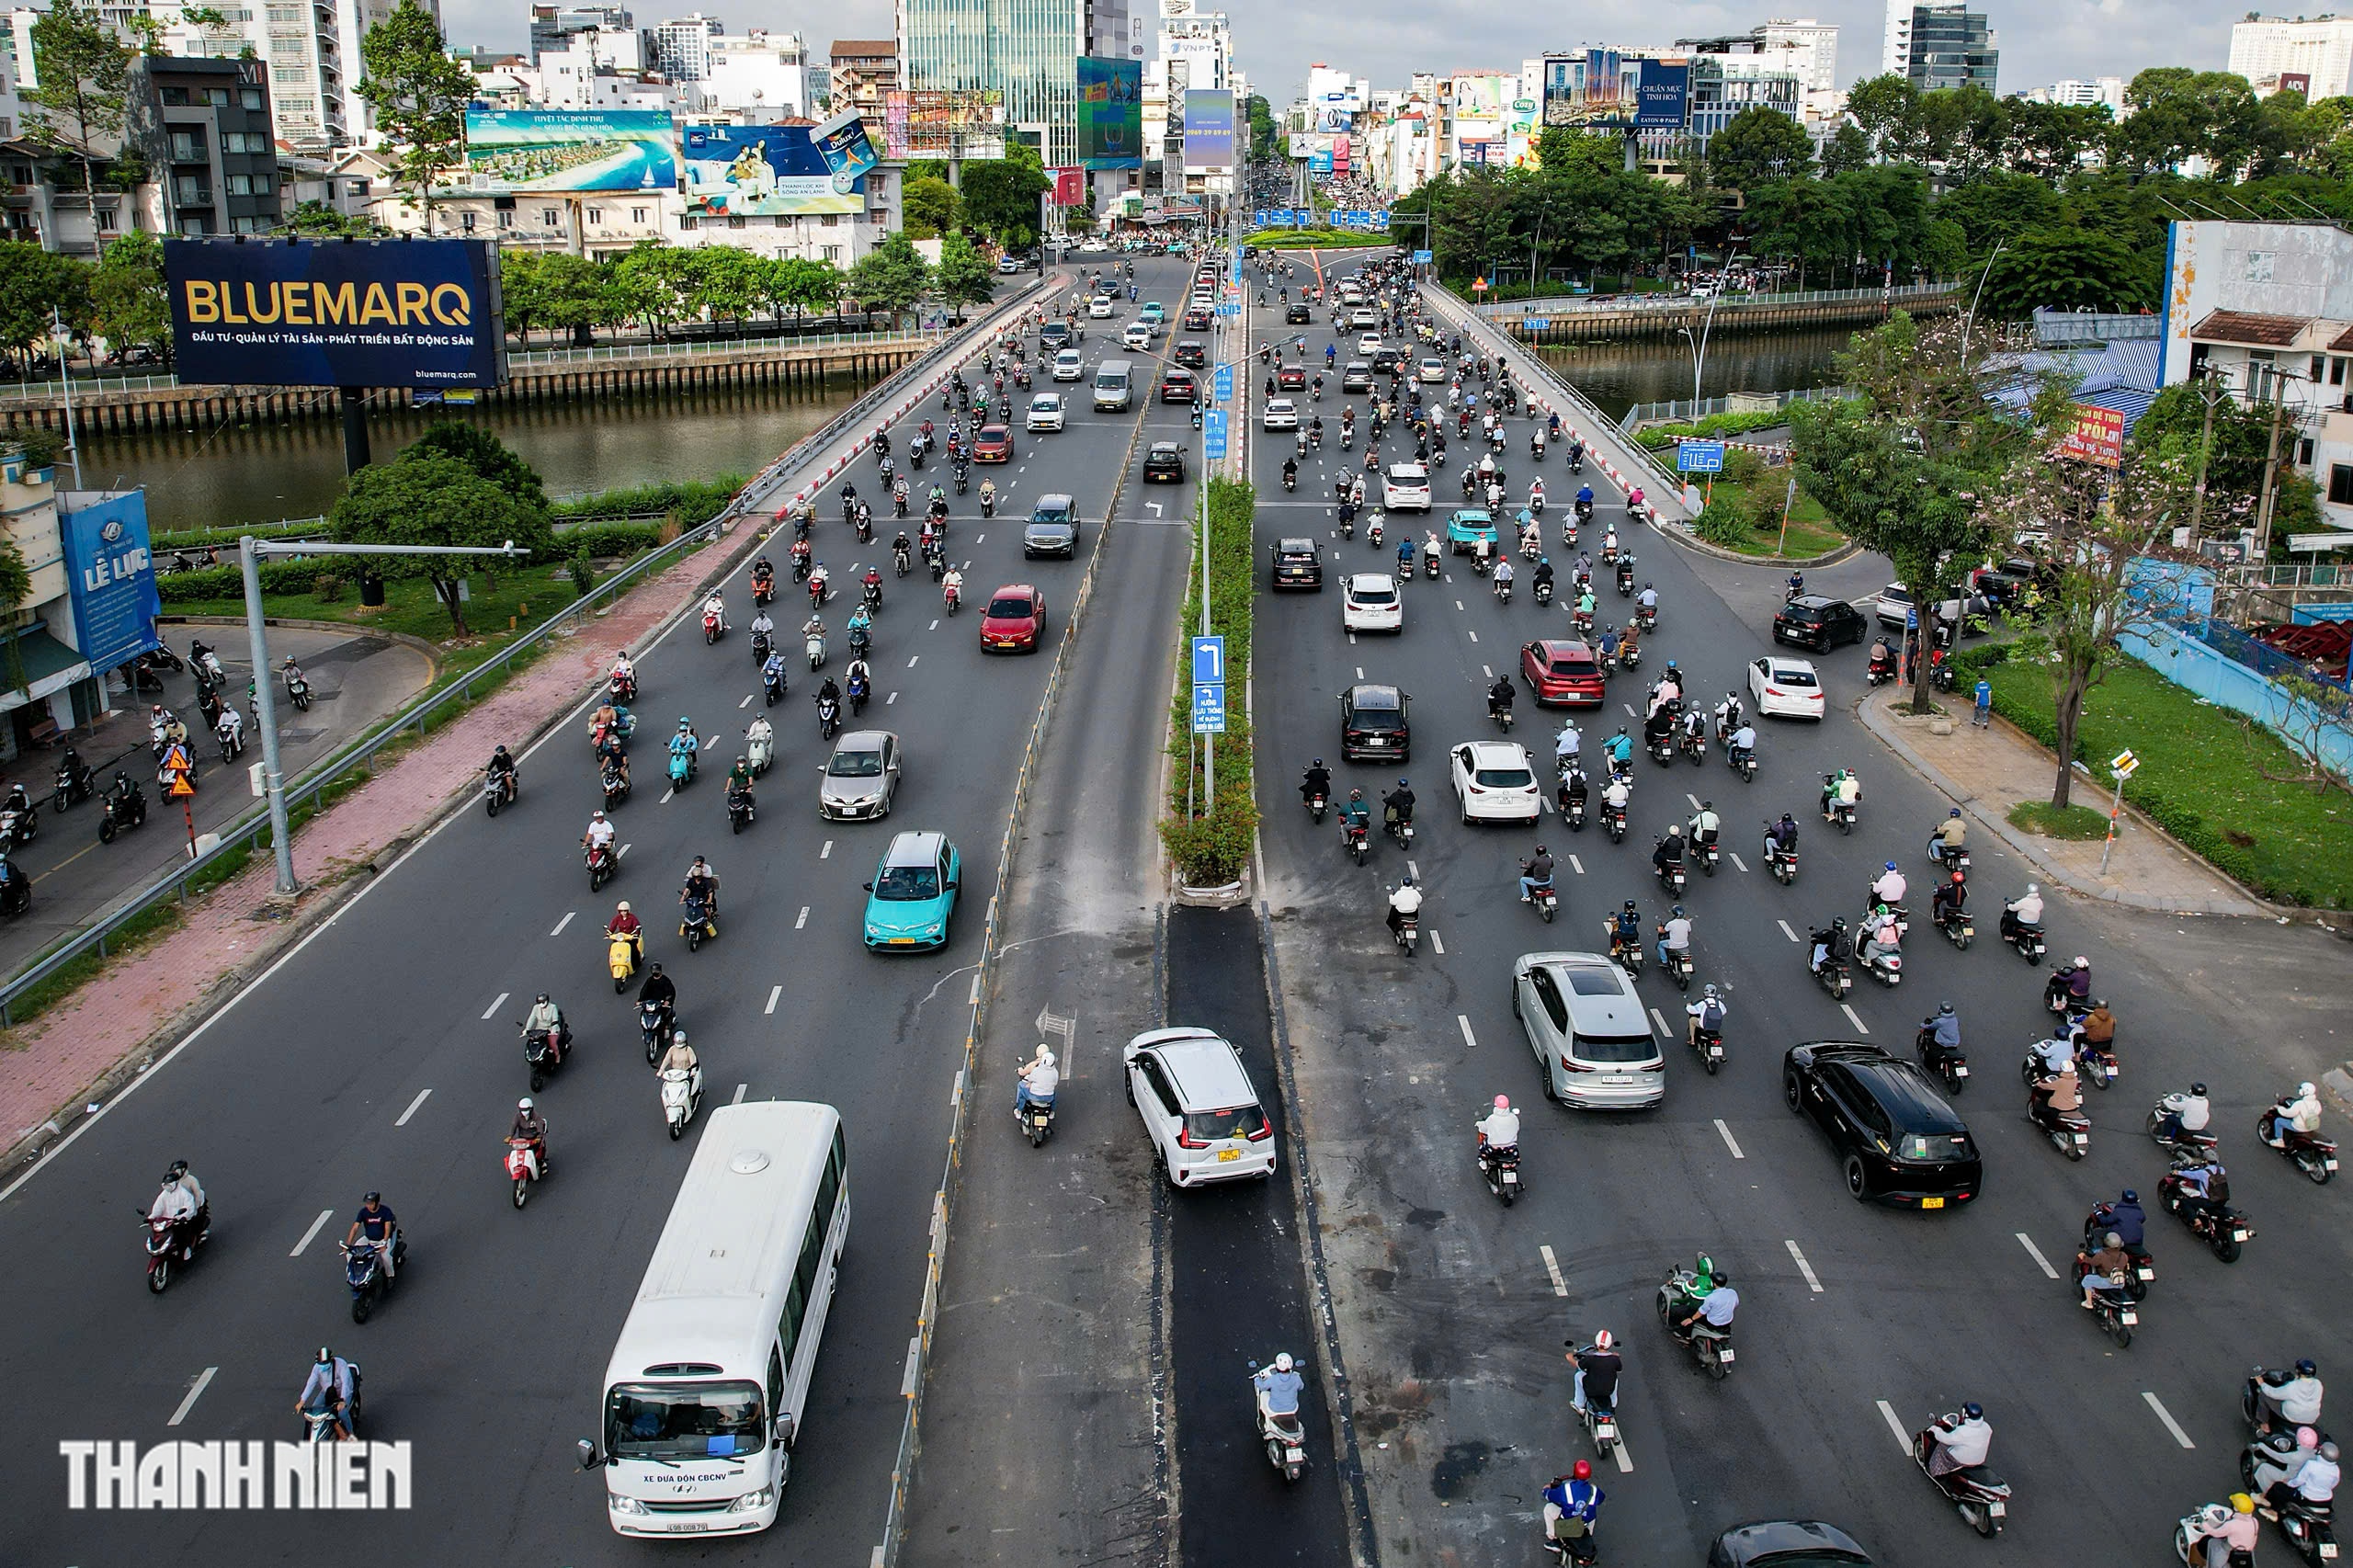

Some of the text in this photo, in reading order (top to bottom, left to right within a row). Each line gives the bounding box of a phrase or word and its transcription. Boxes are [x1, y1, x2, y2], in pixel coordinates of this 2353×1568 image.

[1514, 100, 1534, 110] Cozy
[830, 133, 853, 150] Dulux
[186, 280, 471, 325] BLUEMARQ
[192, 331, 473, 347] ĐẦU TƯ QUẢN LÝ TÀI SẢN PHÁT TRIỂN BẤT ĐỘNG SẢN
[415, 369, 477, 380] bluemarq.com
[85, 547, 149, 592] LÊ LỰC
[698, 1473, 726, 1482] CBCNV
